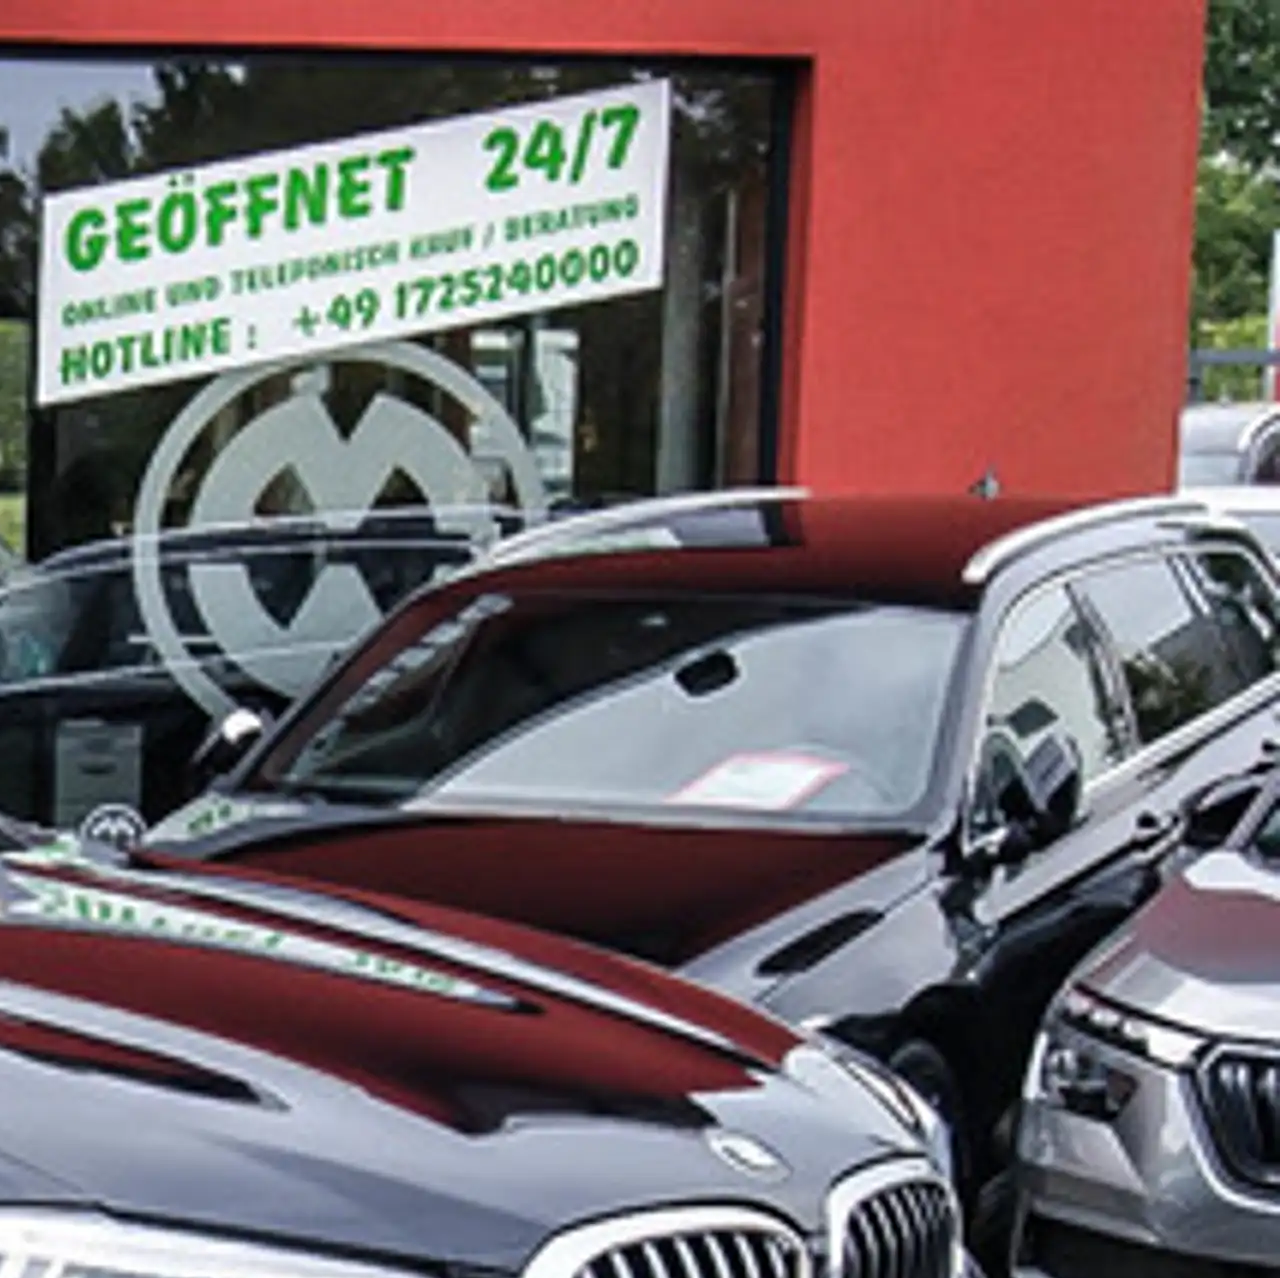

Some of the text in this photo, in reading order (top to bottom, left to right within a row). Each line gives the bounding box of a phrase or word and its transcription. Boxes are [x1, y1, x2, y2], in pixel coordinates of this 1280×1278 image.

[64, 103, 639, 272] GEÖFFNET 24/7
[61, 288, 156, 327] ONLINE
[165, 275, 221, 307] UND
[229, 240, 400, 295] TELEFONISCH
[409, 224, 473, 259] KAUF
[504, 193, 639, 242] BERATUNG
[292, 287, 380, 337] +49
[395, 239, 639, 319] 1725240000
